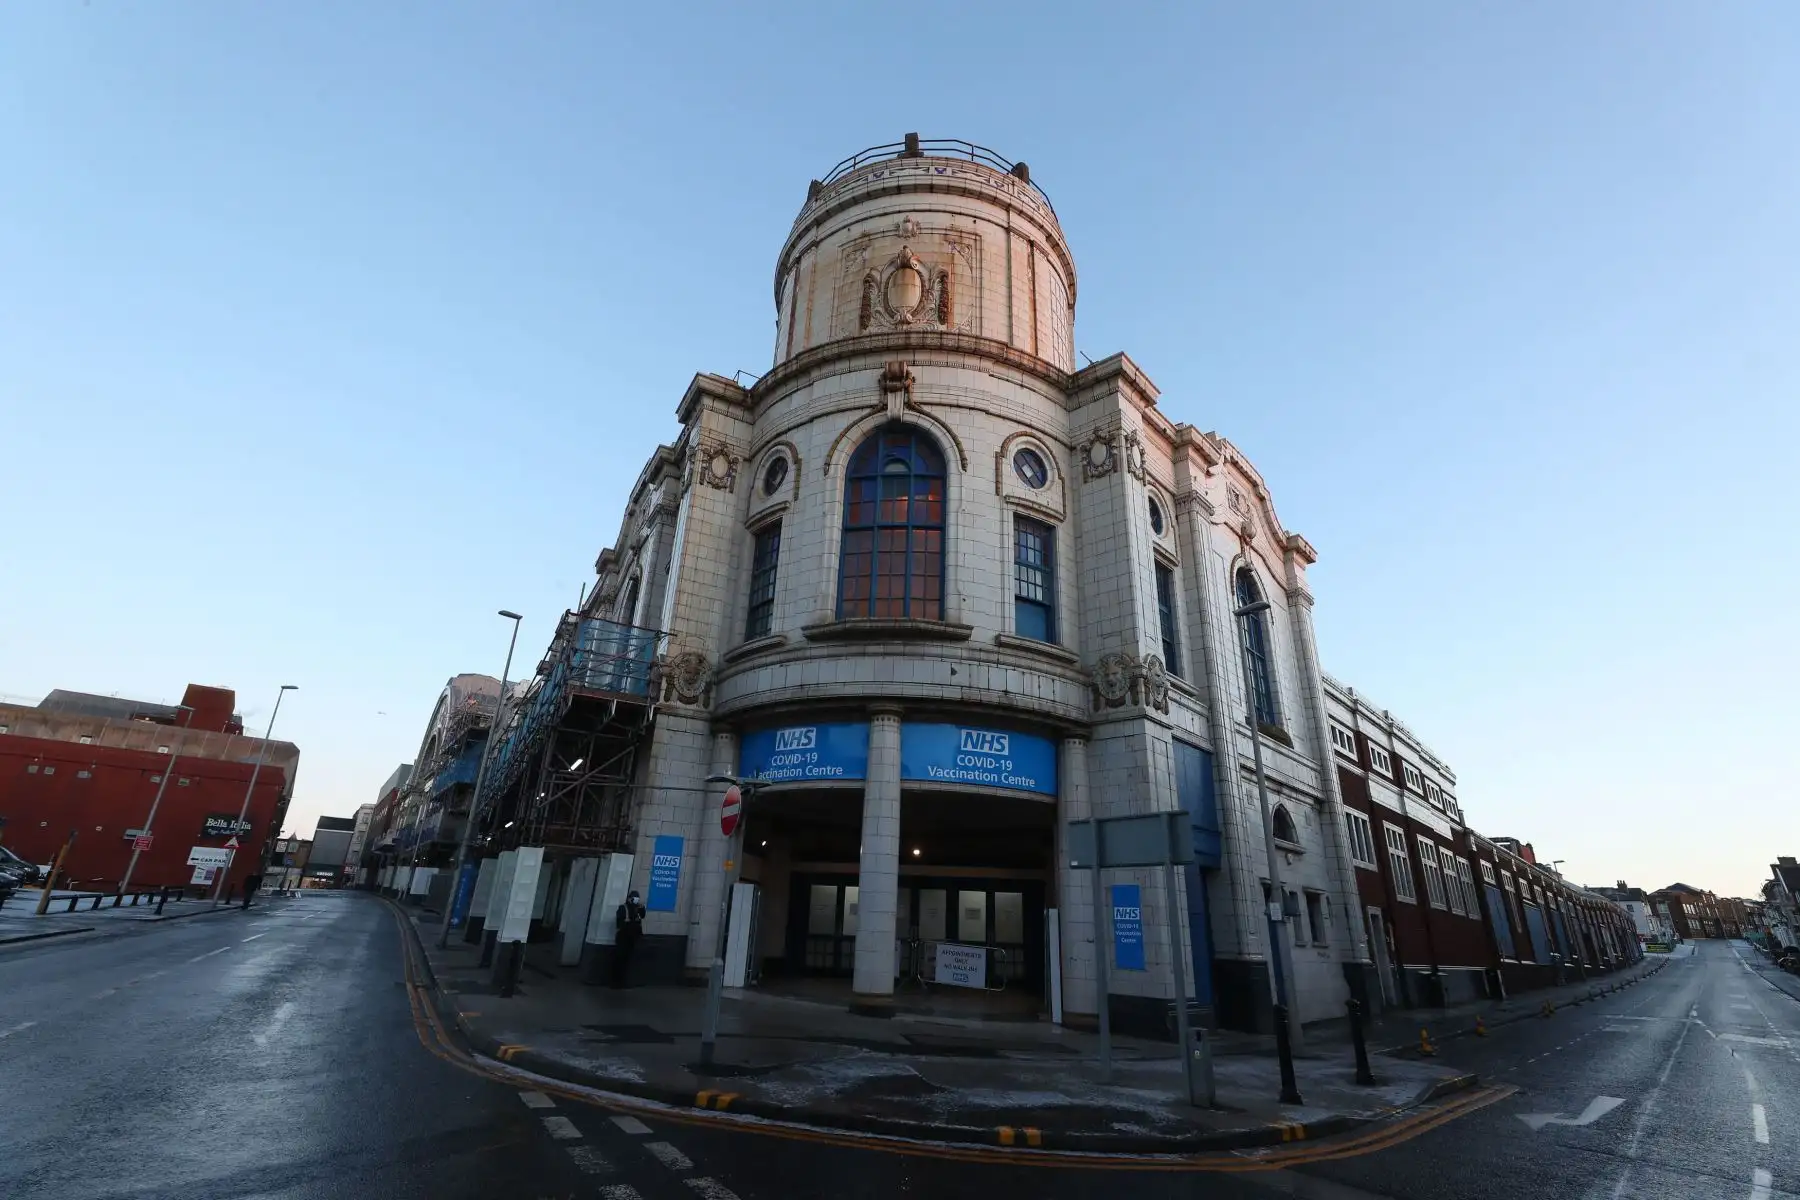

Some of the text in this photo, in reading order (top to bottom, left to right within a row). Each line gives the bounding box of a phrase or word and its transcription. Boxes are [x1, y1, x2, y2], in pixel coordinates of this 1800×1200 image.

[776, 727, 816, 750] NHS
[962, 730, 1008, 754] NHS
[772, 752, 818, 766] COVID-19
[957, 754, 1013, 771] COVID-19
[805, 765, 843, 776] Centre
[928, 765, 1036, 788] Vaccination Centre
[205, 818, 228, 828] Bella
[654, 855, 680, 867] NHS
[1114, 907, 1140, 920] NHS
